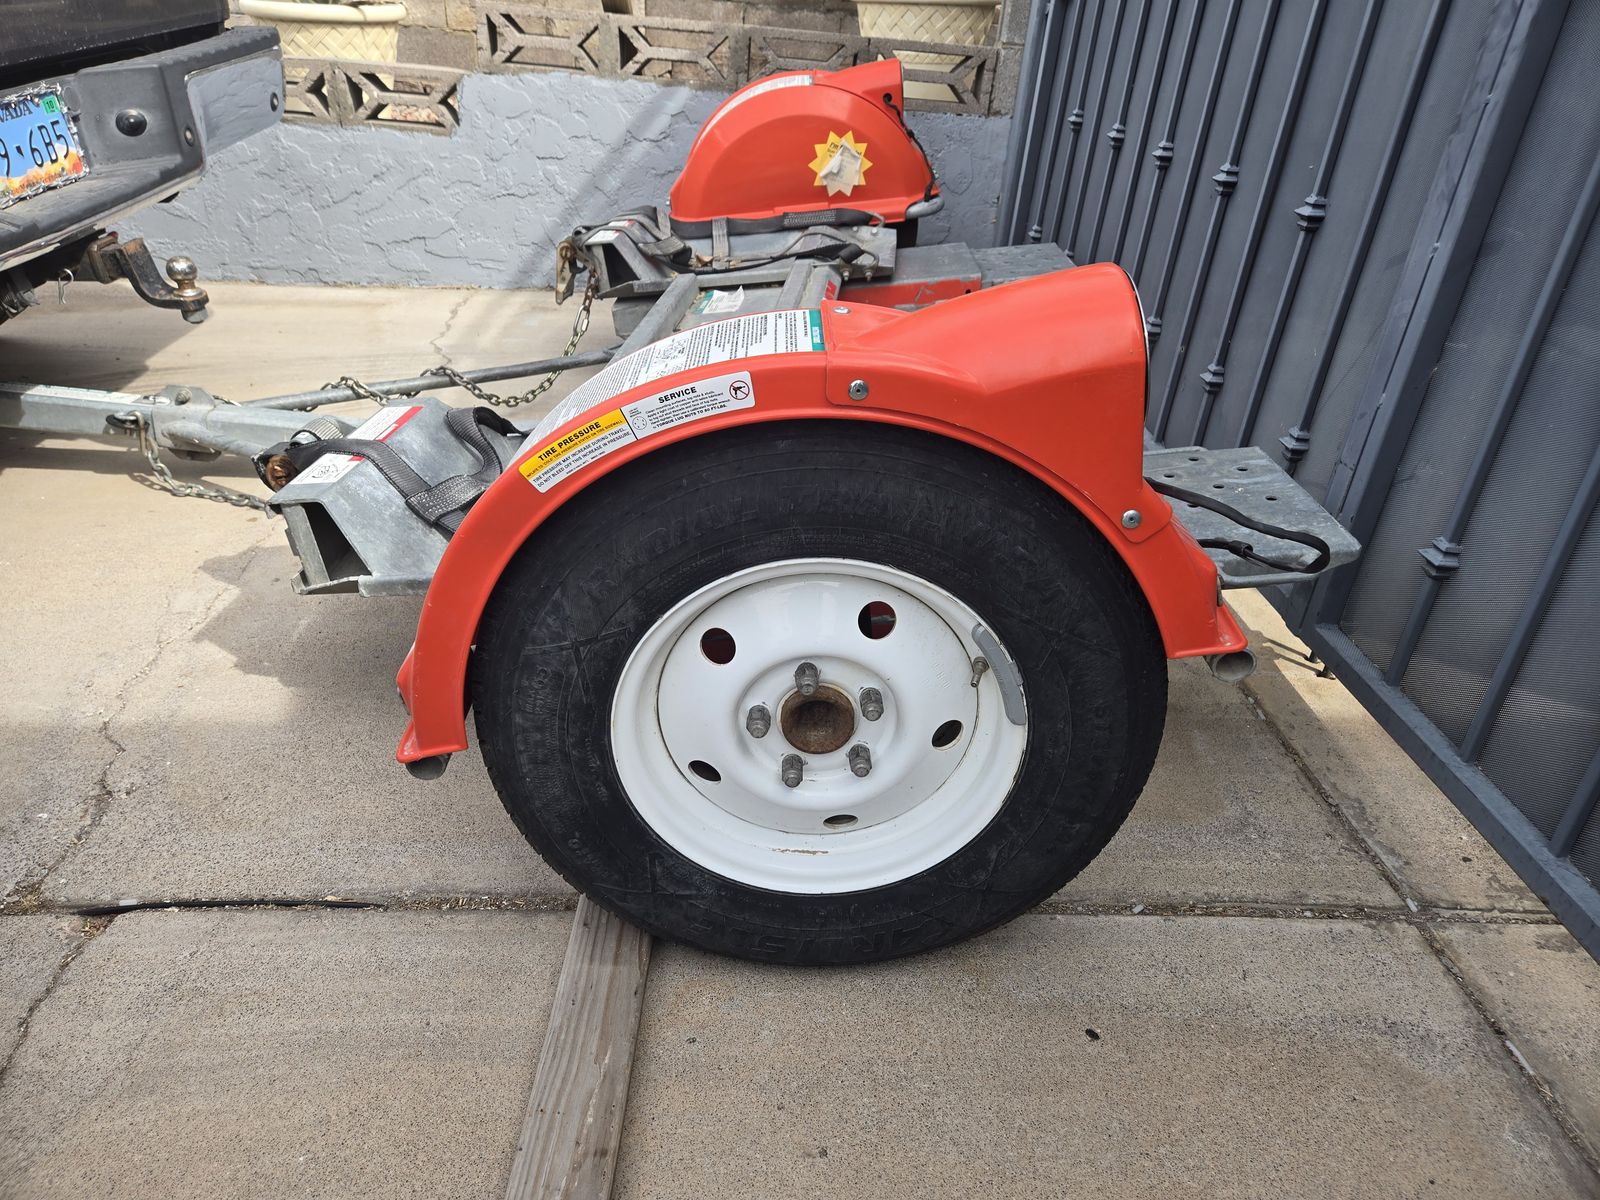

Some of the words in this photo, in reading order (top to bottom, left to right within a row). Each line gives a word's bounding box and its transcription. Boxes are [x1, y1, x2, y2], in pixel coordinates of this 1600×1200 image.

[46, 99, 55, 110] 10
[658, 387, 697, 403] SERVICE
[657, 419, 674, 427] TORQUE
[538, 446, 557, 461] TIRE
[558, 422, 601, 449] PRESSURE
[533, 475, 542, 483] TIRE
[542, 462, 562, 477] PRESSURE
[571, 443, 592, 457] INCREASE
[591, 435, 608, 446] DURING
[544, 475, 552, 483] NOT
[552, 467, 565, 477] BLEED
[572, 456, 582, 464] THIS
[582, 445, 602, 458] INCREASE
